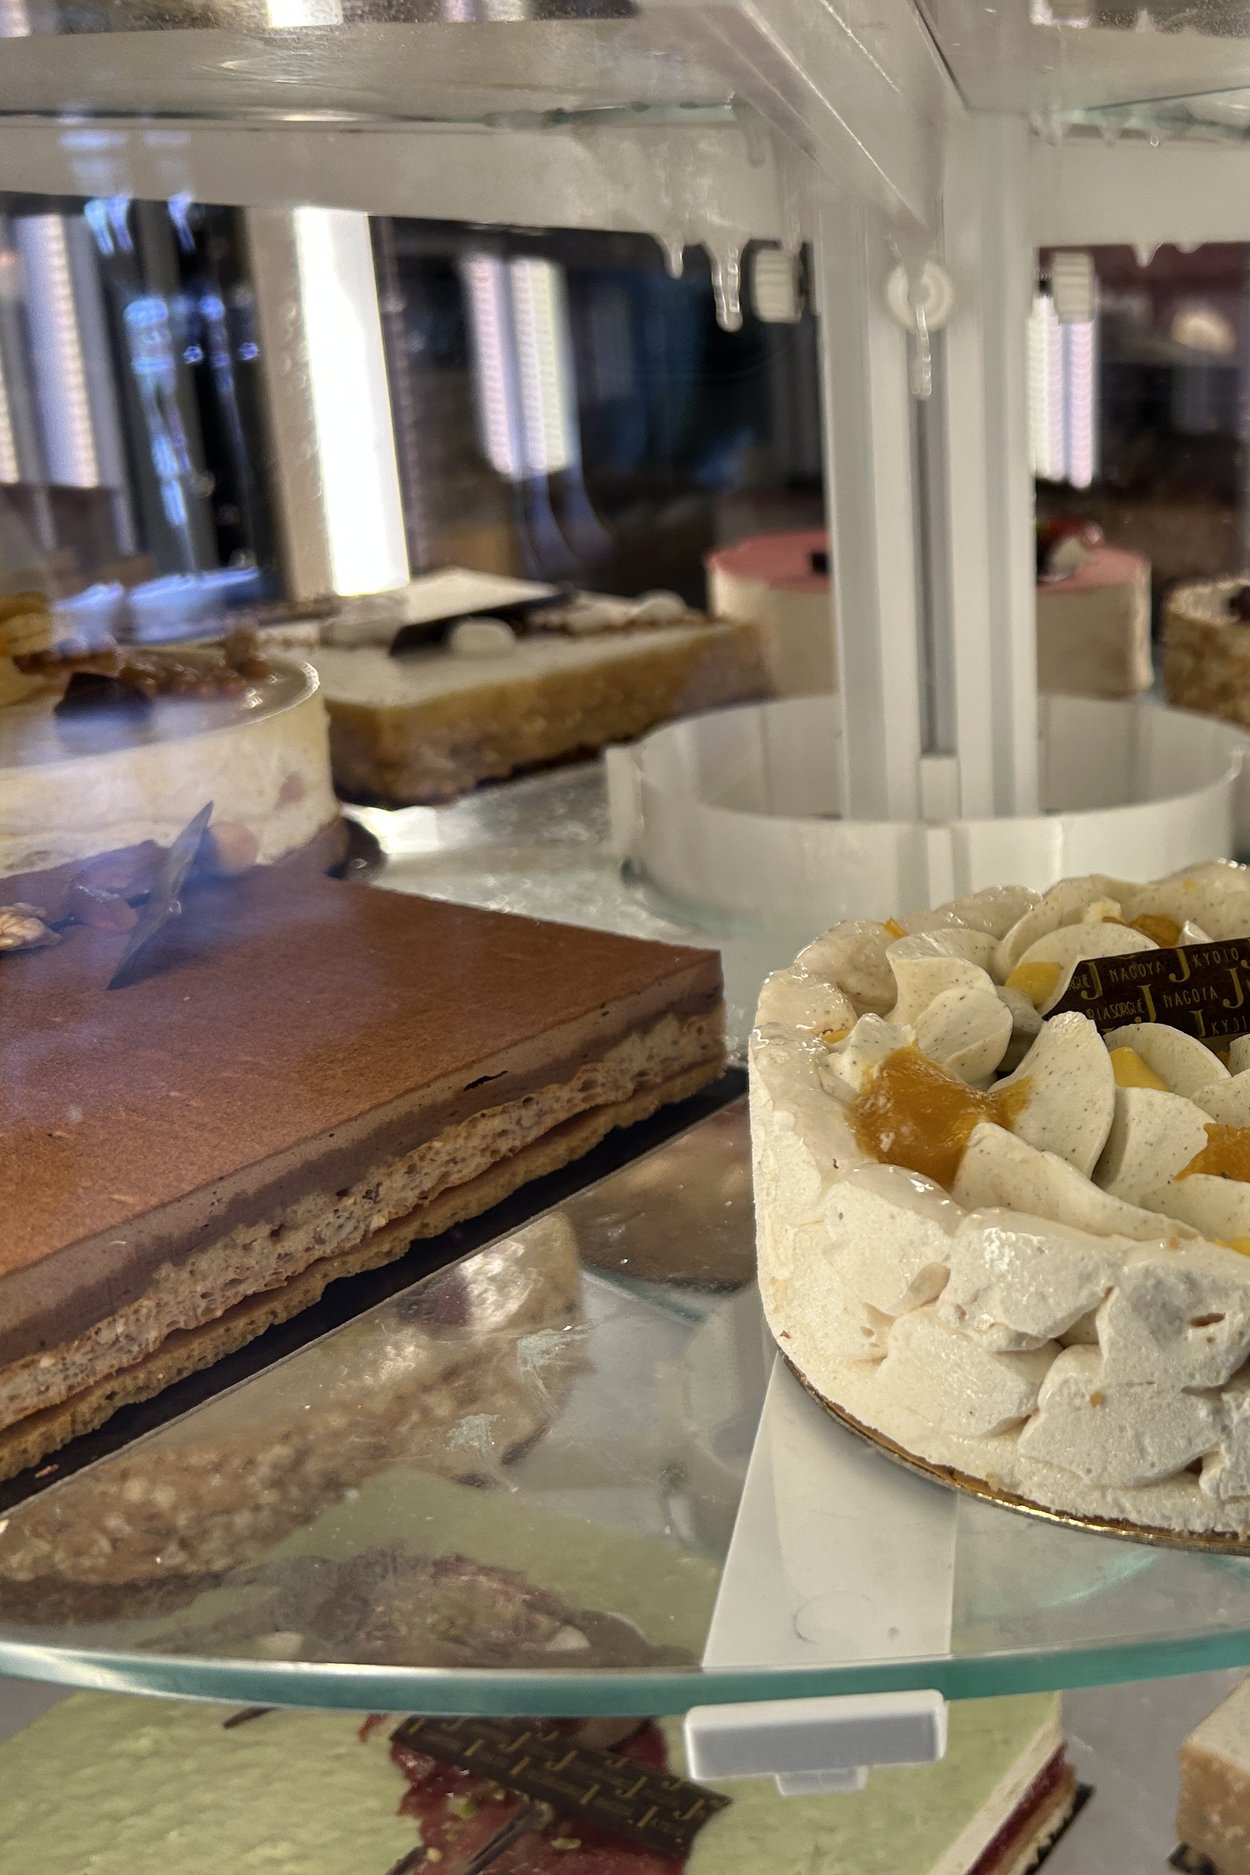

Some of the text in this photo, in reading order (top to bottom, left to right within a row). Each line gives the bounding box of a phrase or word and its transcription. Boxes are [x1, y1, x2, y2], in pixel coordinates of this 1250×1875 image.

[1080, 961, 1103, 1000] J
[1109, 960, 1162, 983] NAGOYA
[1168, 948, 1191, 983] J
[1191, 947, 1240, 968] KYOTO
[1162, 985, 1218, 1009] NAGOYA
[1222, 966, 1245, 1009] J
